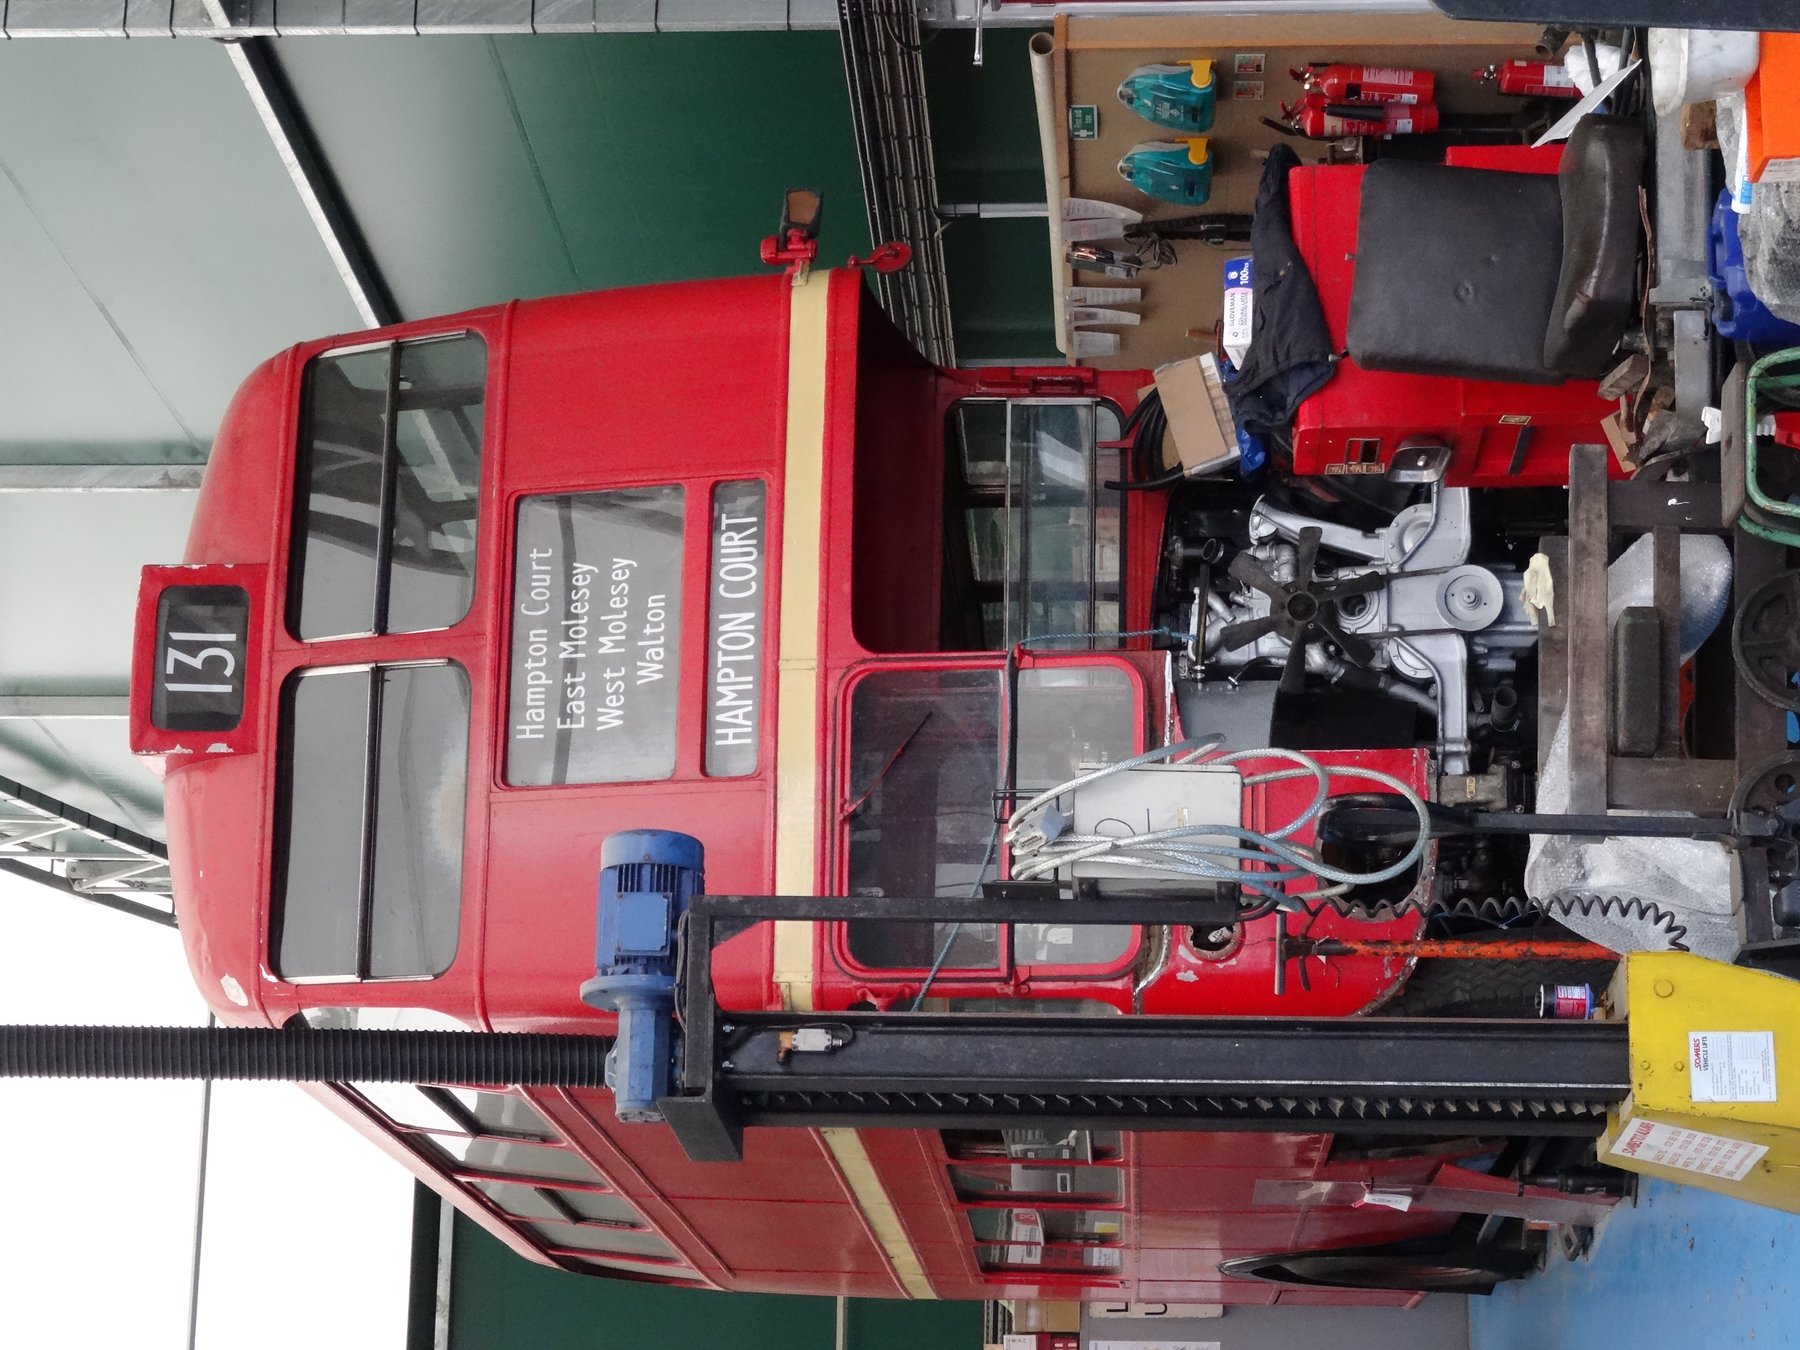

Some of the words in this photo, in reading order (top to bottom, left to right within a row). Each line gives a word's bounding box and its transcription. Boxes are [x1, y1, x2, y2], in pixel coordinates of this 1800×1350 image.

[521, 548, 552, 616] Court
[719, 513, 758, 598] COURT
[559, 563, 598, 658] Molesey
[599, 557, 637, 653] Molesey
[636, 594, 666, 685] Walton
[164, 632, 237, 693] 131
[516, 629, 553, 739] Hampton
[557, 672, 586, 730] East
[596, 667, 625, 731] West
[715, 612, 755, 746] HAMPTON
[1693, 1038, 1701, 1071] SOMERS
